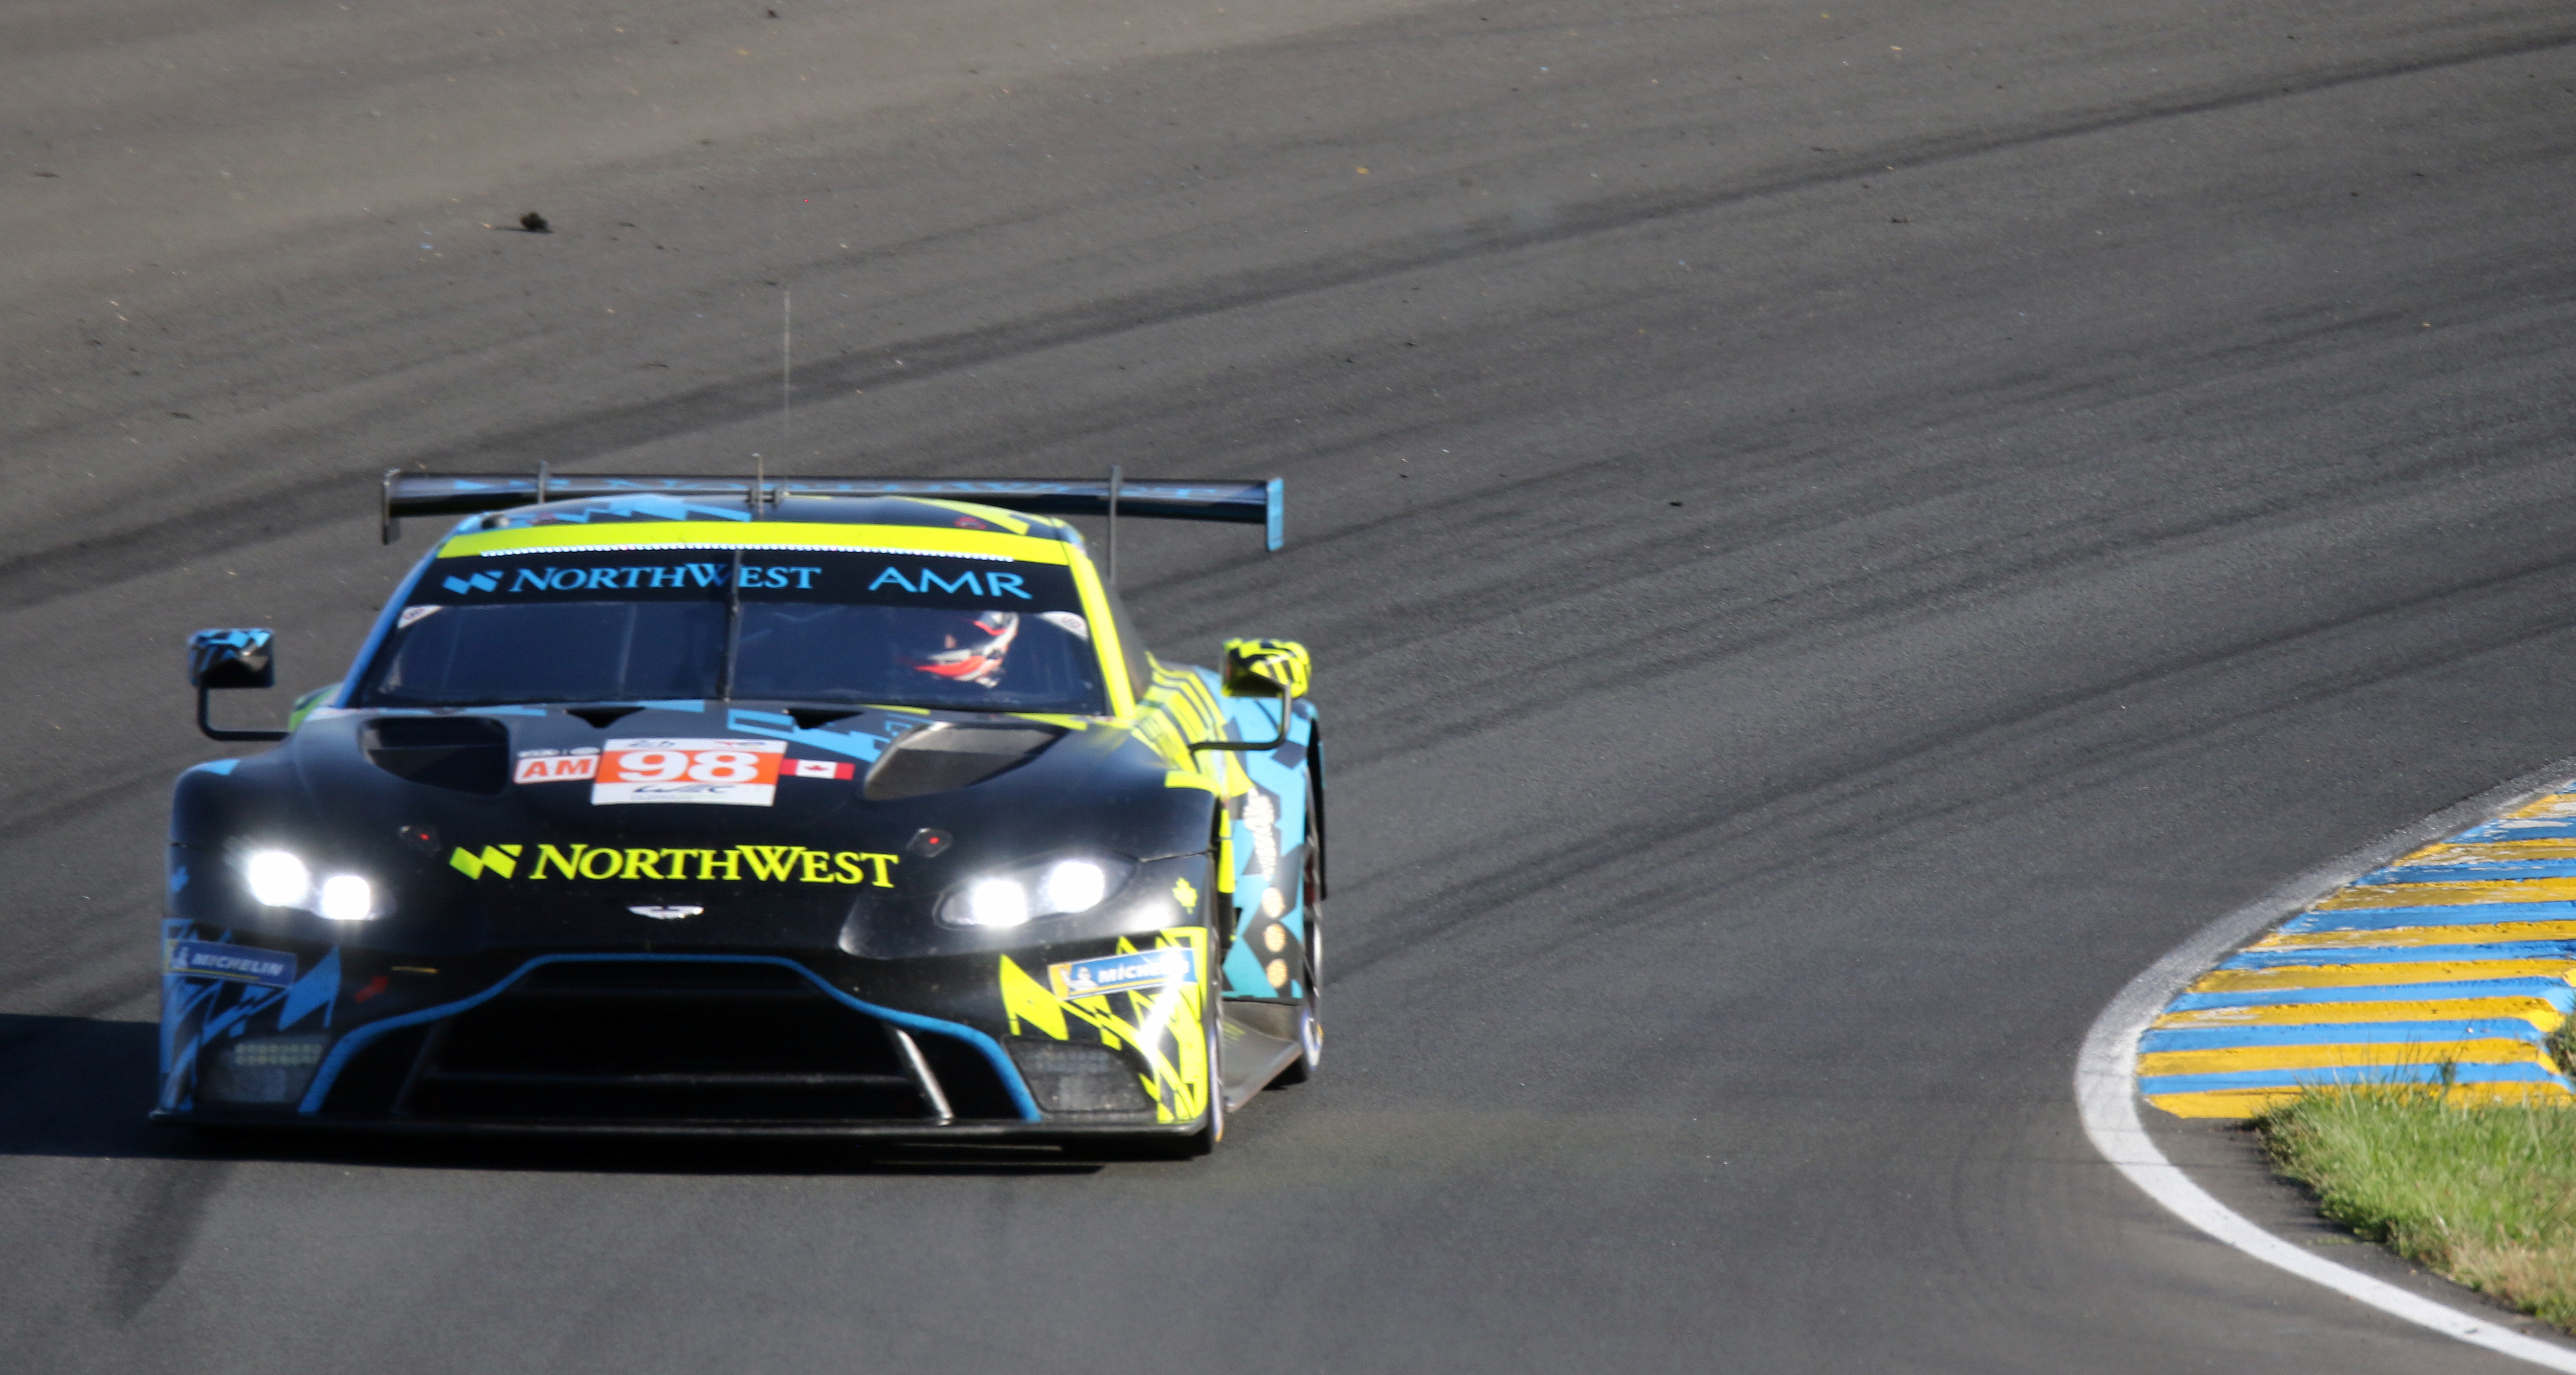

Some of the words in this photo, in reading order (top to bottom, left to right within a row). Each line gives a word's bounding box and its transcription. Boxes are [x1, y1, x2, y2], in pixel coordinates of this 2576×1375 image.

[868, 566, 1033, 599] AMR
[522, 759, 592, 778] AM
[618, 750, 759, 783] 98
[529, 843, 899, 888] NORTHWEST
[191, 953, 285, 976] MICHELIN
[1098, 957, 1190, 983] MICHE
